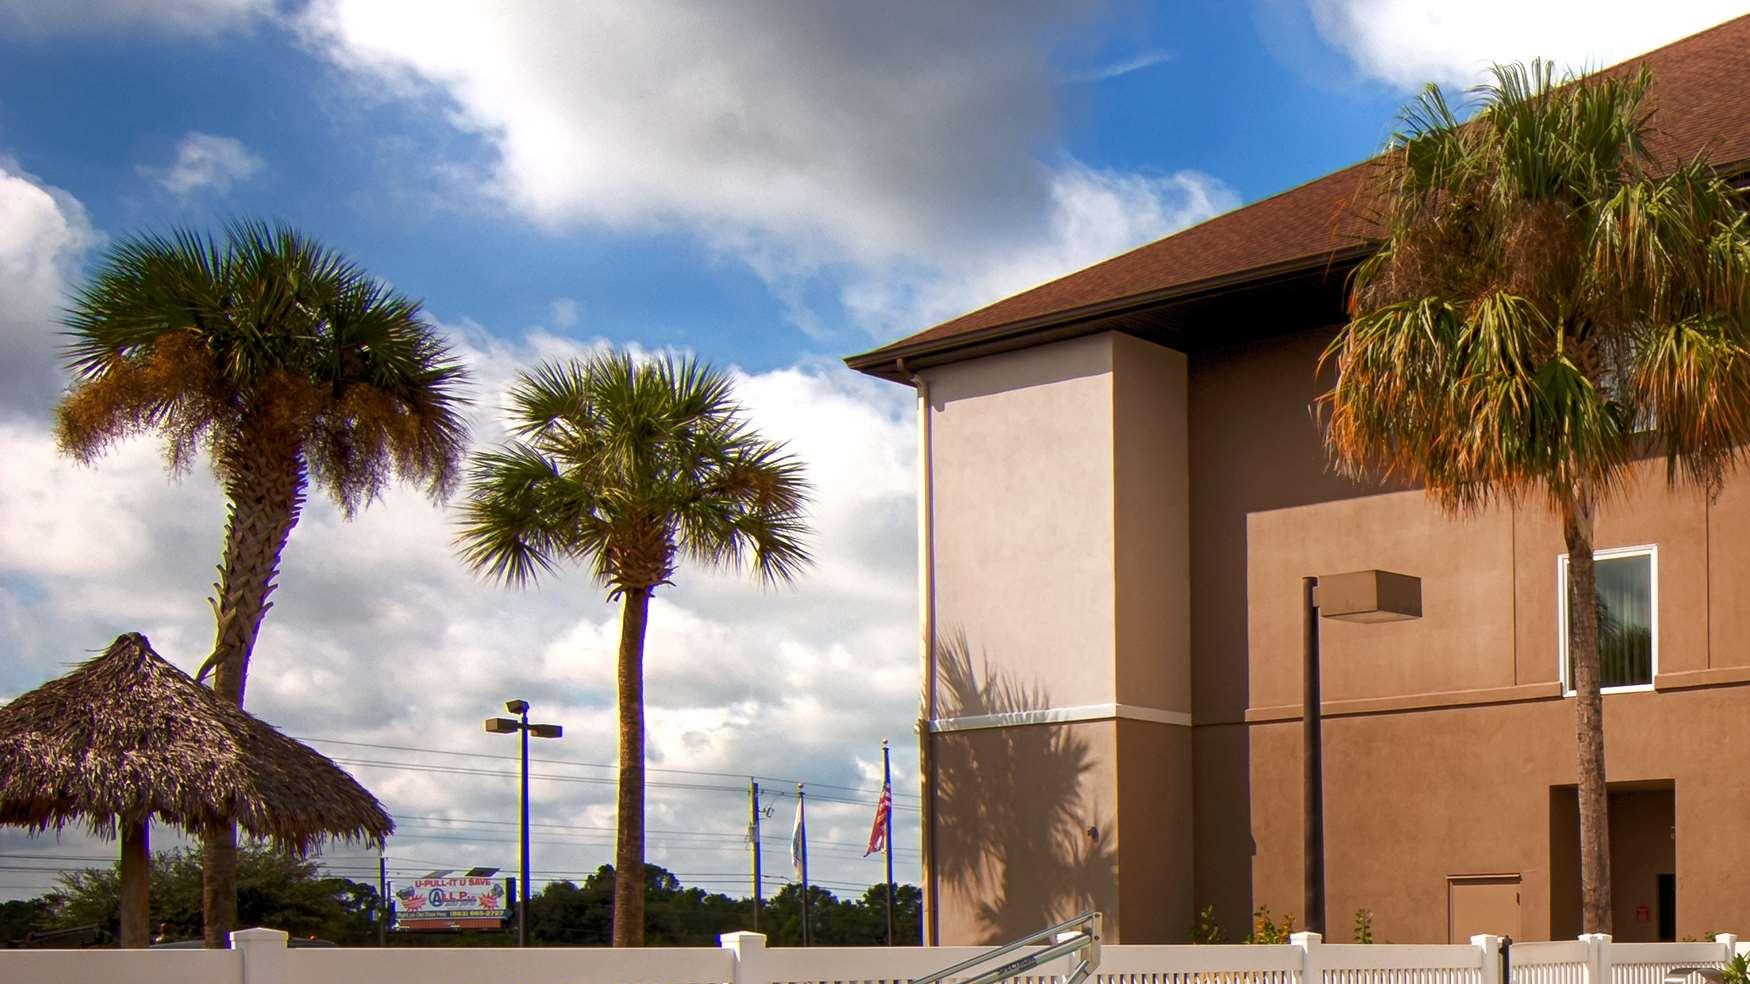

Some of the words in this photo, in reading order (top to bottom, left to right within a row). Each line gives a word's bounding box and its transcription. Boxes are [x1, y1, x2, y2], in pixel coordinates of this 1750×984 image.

[415, 879, 457, 888] U-PULL-IT
[459, 878, 467, 887] U
[469, 877, 491, 887] SAVE
